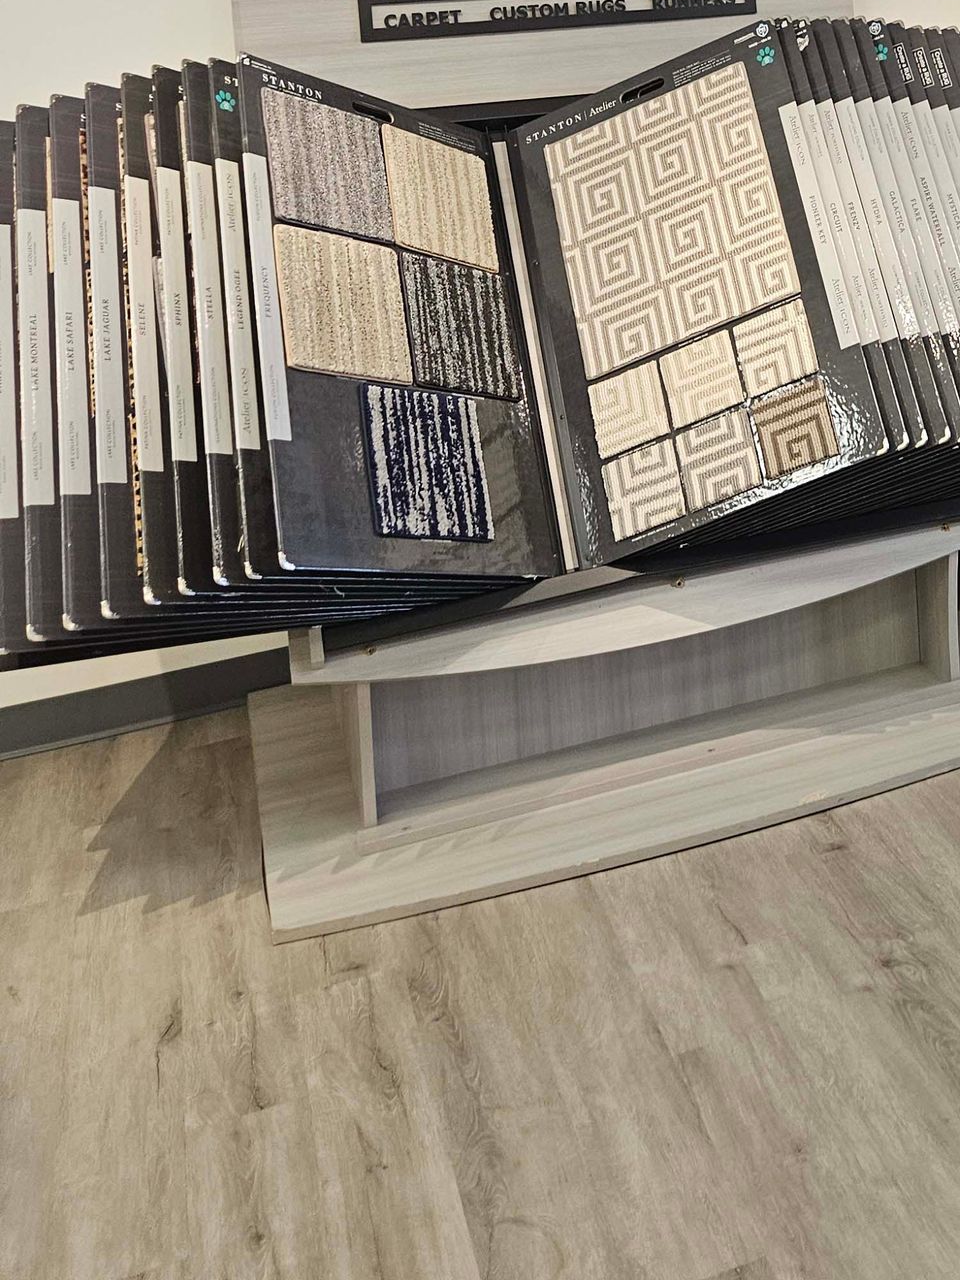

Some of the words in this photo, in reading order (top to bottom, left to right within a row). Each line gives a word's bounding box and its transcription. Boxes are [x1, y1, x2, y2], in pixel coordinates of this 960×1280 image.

[384, 10, 462, 28] CARPET
[490, 2, 568, 21] CUSTOM
[897, 46, 905, 63] Create
[904, 68, 912, 80] RUG
[917, 50, 925, 67] Create
[924, 72, 932, 84] RUG
[935, 52, 943, 68] Create
[942, 72, 950, 85] RUG
[261, 73, 323, 100] STANTON
[525, 112, 582, 145] STANTON
[589, 98, 617, 117] Atelier
[823, 109, 835, 130] Atelier
[900, 109, 914, 134] Atelier
[908, 136, 919, 159] ICON
[788, 114, 801, 140] Atelier
[795, 142, 806, 165] ICON
[225, 203, 235, 231] Atelier
[808, 195, 822, 228] PIONEER
[817, 229, 827, 244] KEY
[829, 201, 843, 232] CIRCUIT
[847, 201, 860, 231] FRENZY
[870, 198, 882, 225] HYDRA
[888, 189, 905, 233] GALACTICA
[910, 198, 922, 222] FLARE
[919, 175, 931, 201] ASPIRE
[927, 202, 946, 247] WATERFALL
[233, 269, 241, 291] OGEE
[260, 264, 271, 318] FREQUENCY
[851, 274, 863, 297] Atelier
[867, 267, 880, 290] Atelier
[102, 298, 110, 334] JAGUAR
[137, 302, 146, 335] SELENE
[174, 292, 182, 326] SPHINX
[205, 286, 213, 319] STELLA
[235, 295, 244, 330] LEGEND
[831, 277, 846, 304] Atelier
[839, 307, 851, 334] ICON
[29, 313, 38, 363] MONTREAL
[65, 311, 73, 343] SAFARI
[66, 345, 74, 371] LAKE
[103, 336, 111, 360] LAKE
[30, 366, 38, 391] LAKE
[240, 366, 248, 396] ICON
[240, 399, 251, 434] Atelier
